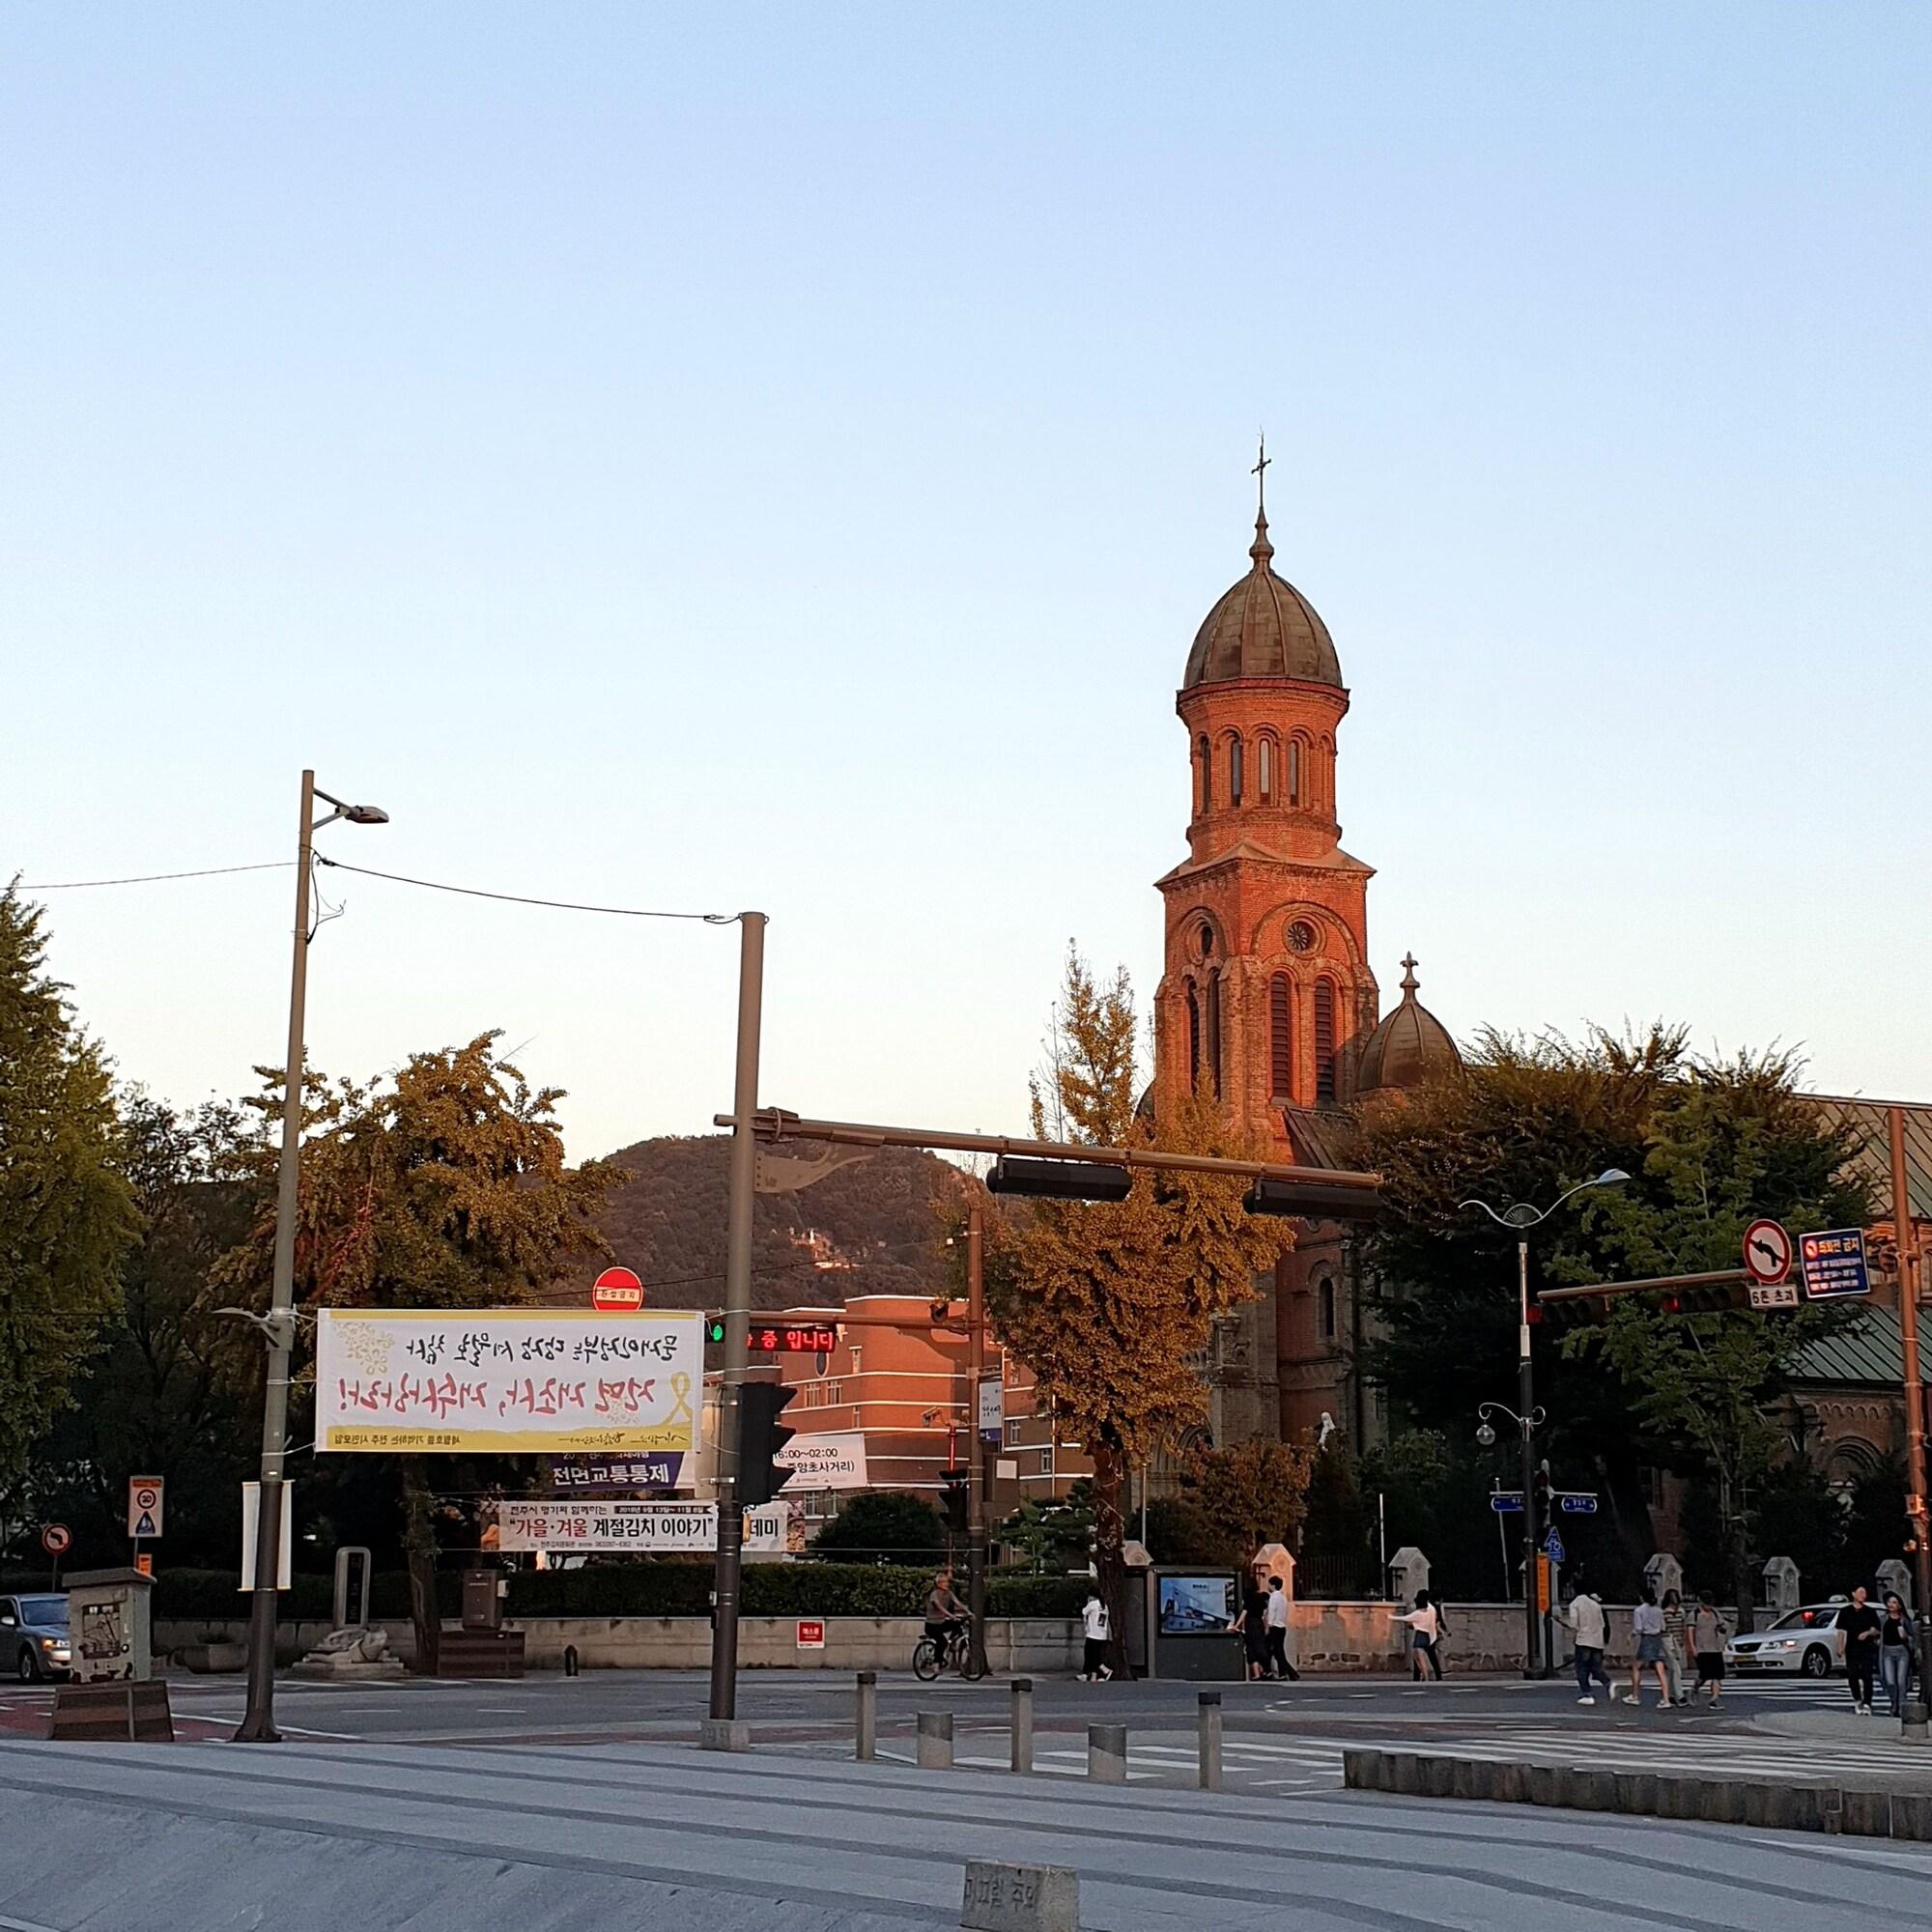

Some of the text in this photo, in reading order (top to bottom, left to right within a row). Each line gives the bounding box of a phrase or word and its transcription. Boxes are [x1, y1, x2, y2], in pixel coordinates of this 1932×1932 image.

[1774, 1288, 1795, 1303] 초과
[761, 1330, 778, 1349] 중
[552, 1463, 670, 1487] 전면교통통제
[510, 1505, 538, 1516] 전주시
[571, 1505, 608, 1516] 함께하는
[592, 1519, 656, 1538] 계절김치
